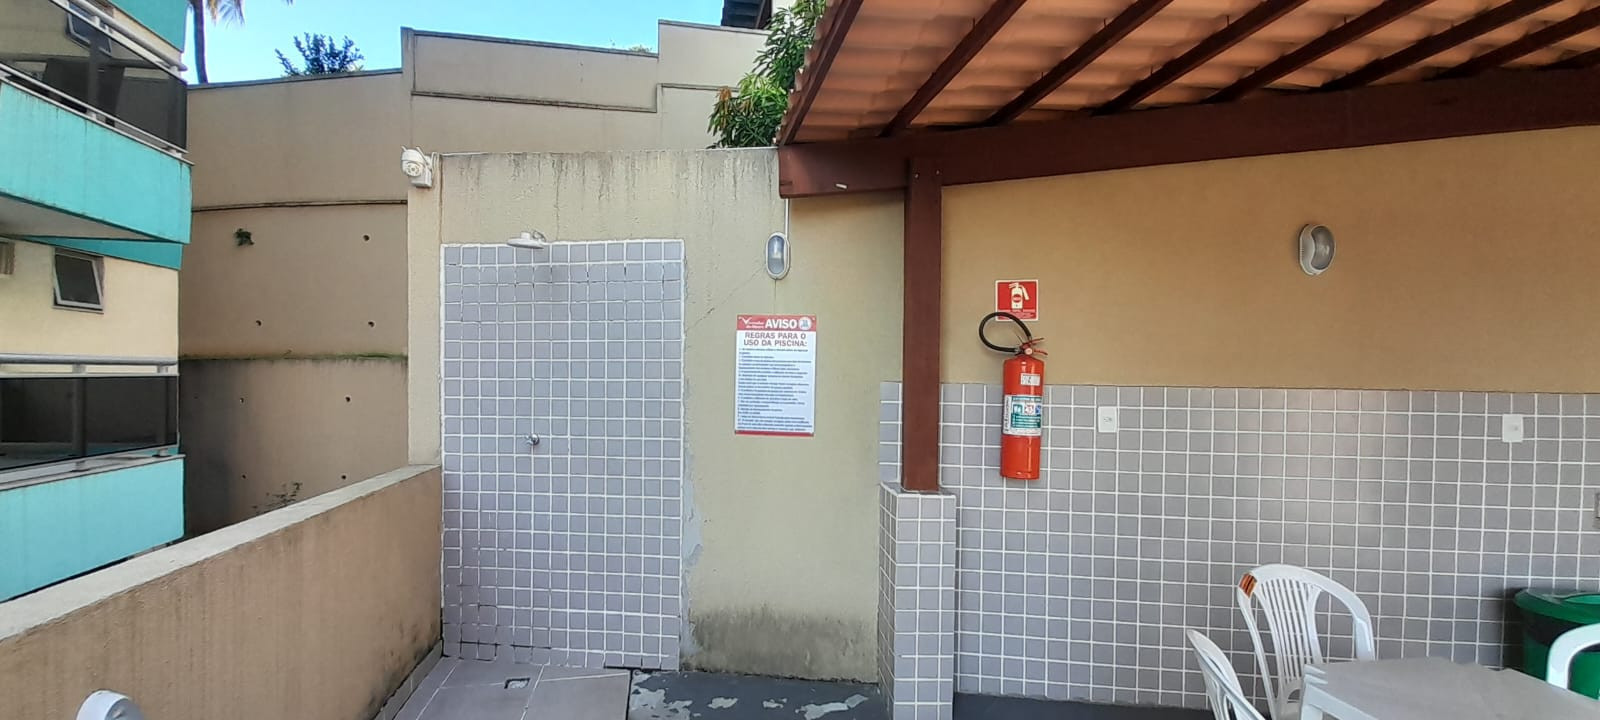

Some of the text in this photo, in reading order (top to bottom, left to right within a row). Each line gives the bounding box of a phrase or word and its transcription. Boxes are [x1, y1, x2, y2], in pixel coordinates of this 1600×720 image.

[765, 318, 798, 329] AVISO
[745, 331, 776, 339] REGRAS
[778, 332, 798, 340] PARA
